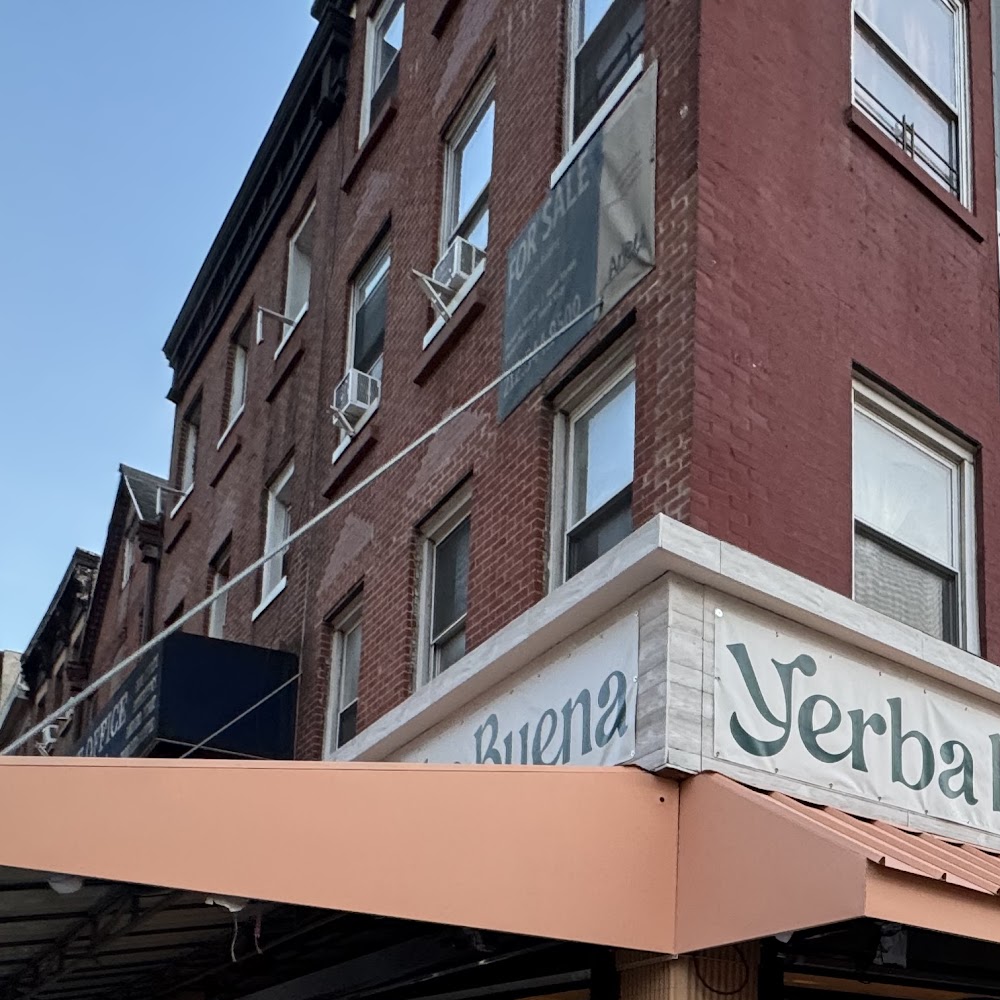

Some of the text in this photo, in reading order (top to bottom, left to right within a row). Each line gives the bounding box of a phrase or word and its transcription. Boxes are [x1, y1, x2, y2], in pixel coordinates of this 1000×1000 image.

[508, 148, 590, 297] FOR SALE
[474, 670, 628, 765] Buena
[725, 642, 978, 805] Yerba
